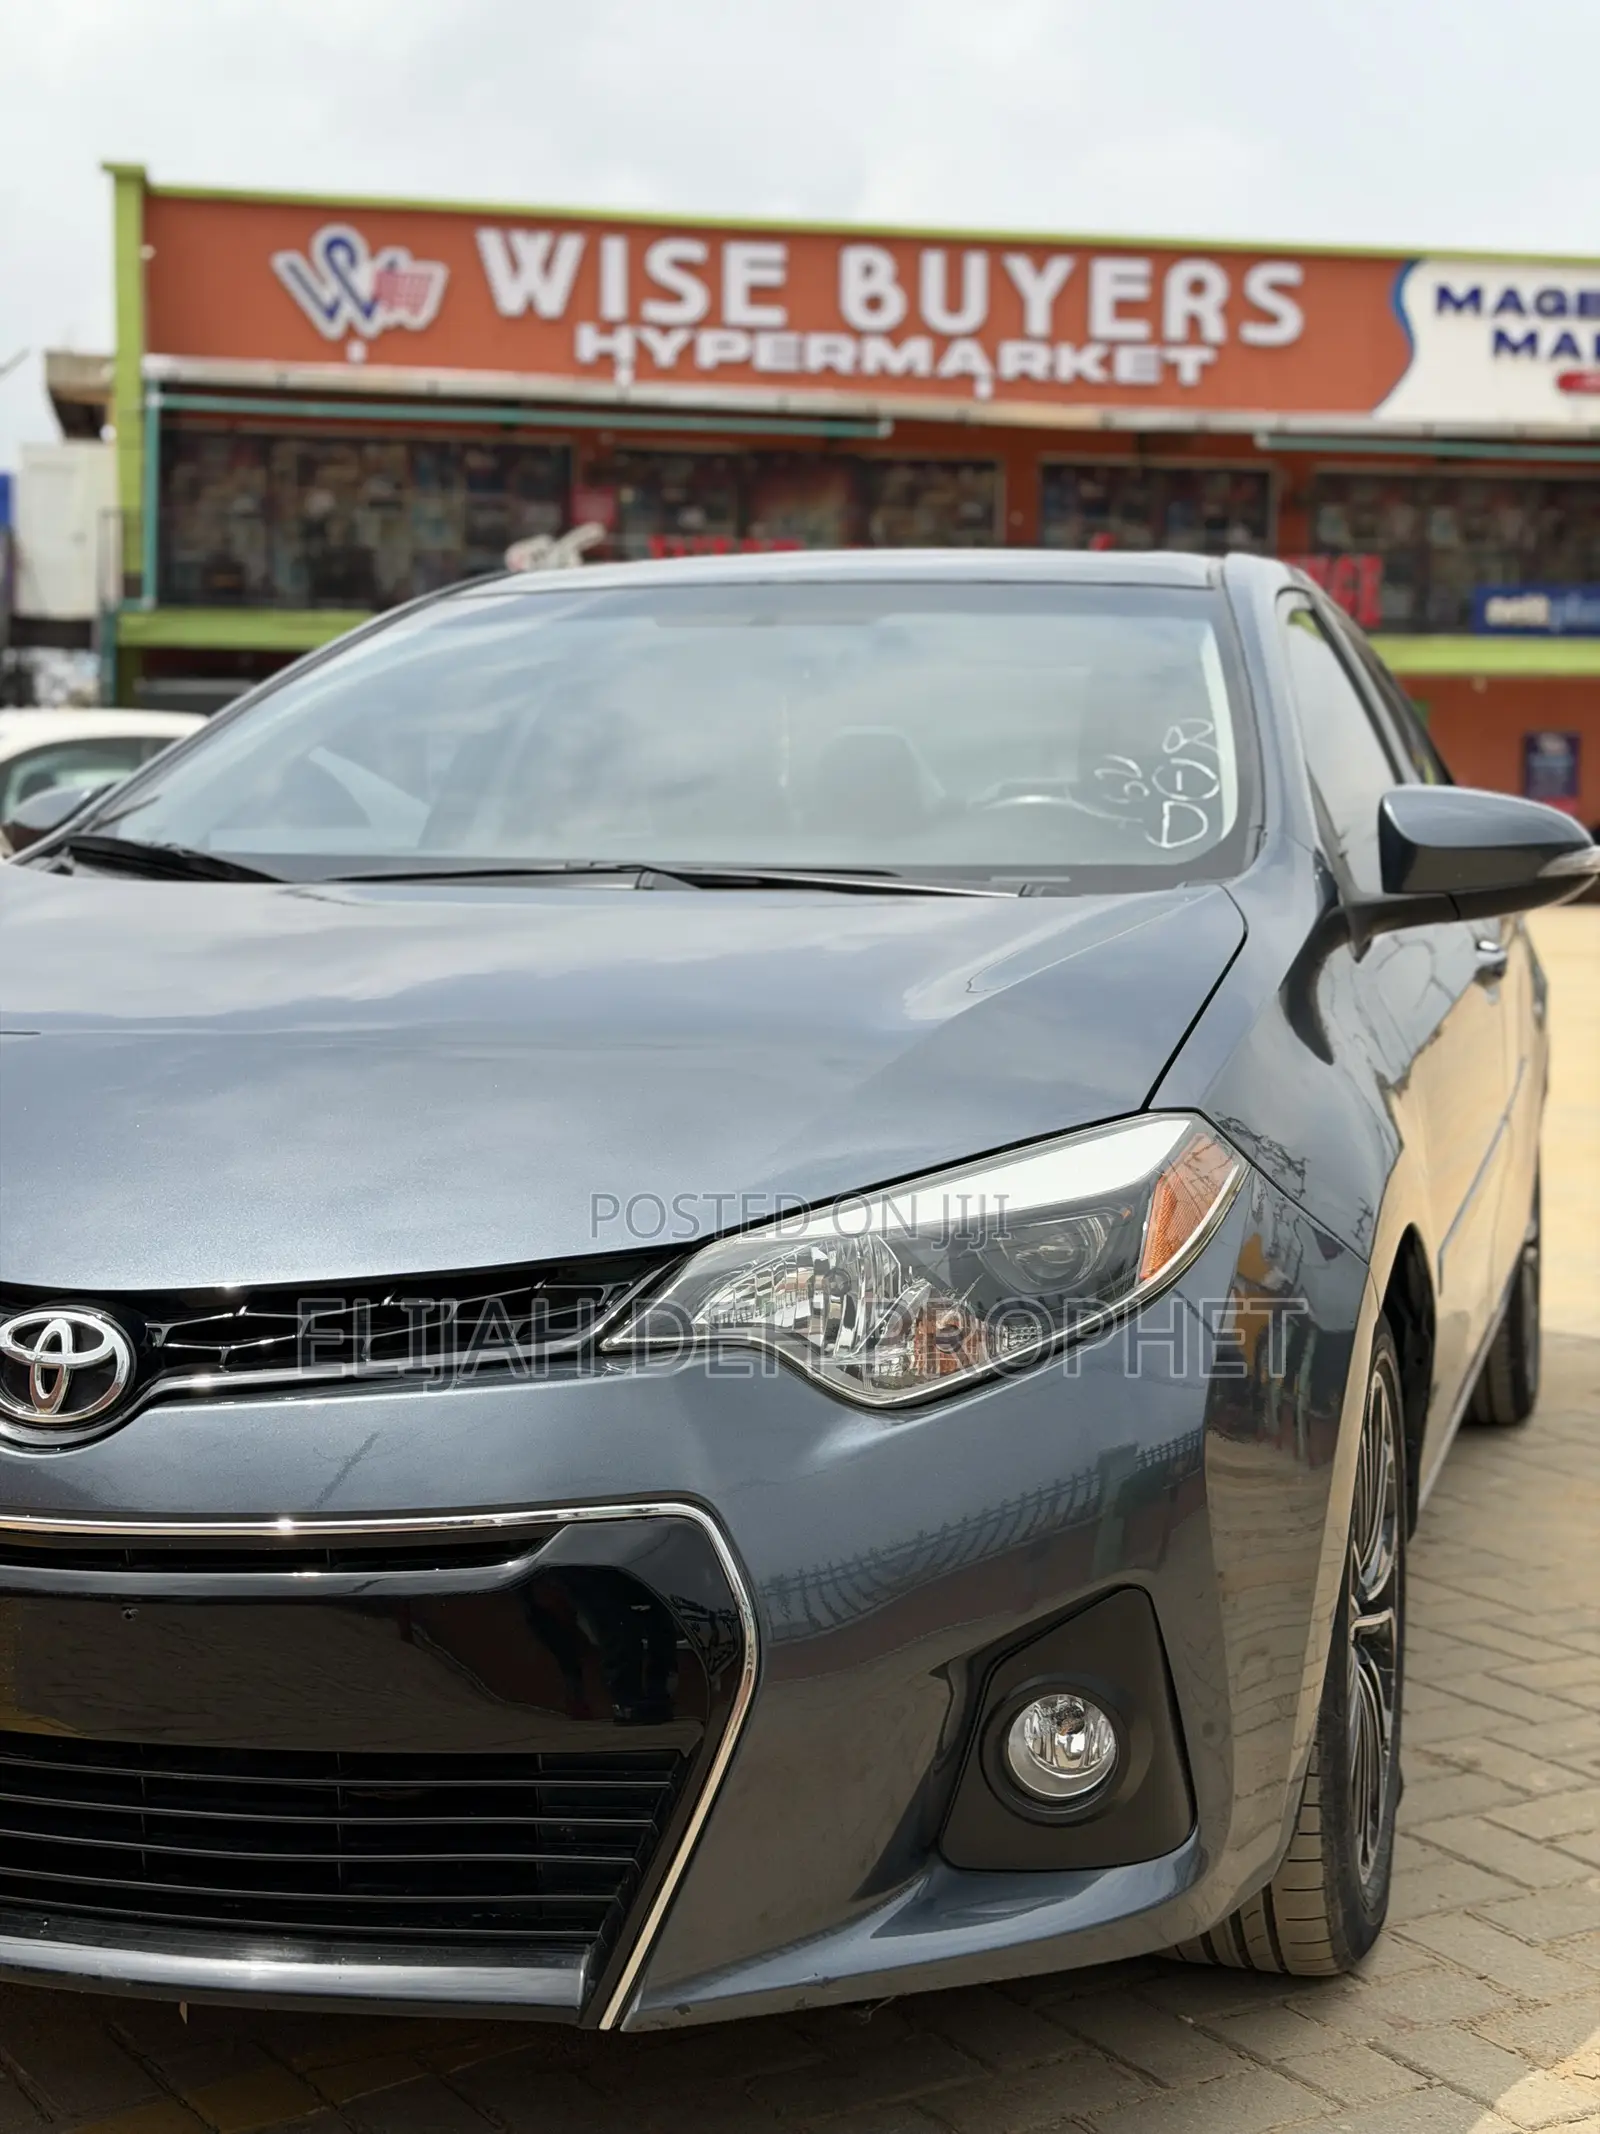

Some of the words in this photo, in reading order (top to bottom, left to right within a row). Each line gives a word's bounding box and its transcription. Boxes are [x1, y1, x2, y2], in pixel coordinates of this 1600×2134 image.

[475, 228, 789, 328] WISE
[838, 245, 1305, 346] BUYERS
[574, 322, 1217, 386] HYPERMARKET
[1493, 329, 1600, 361] MA
